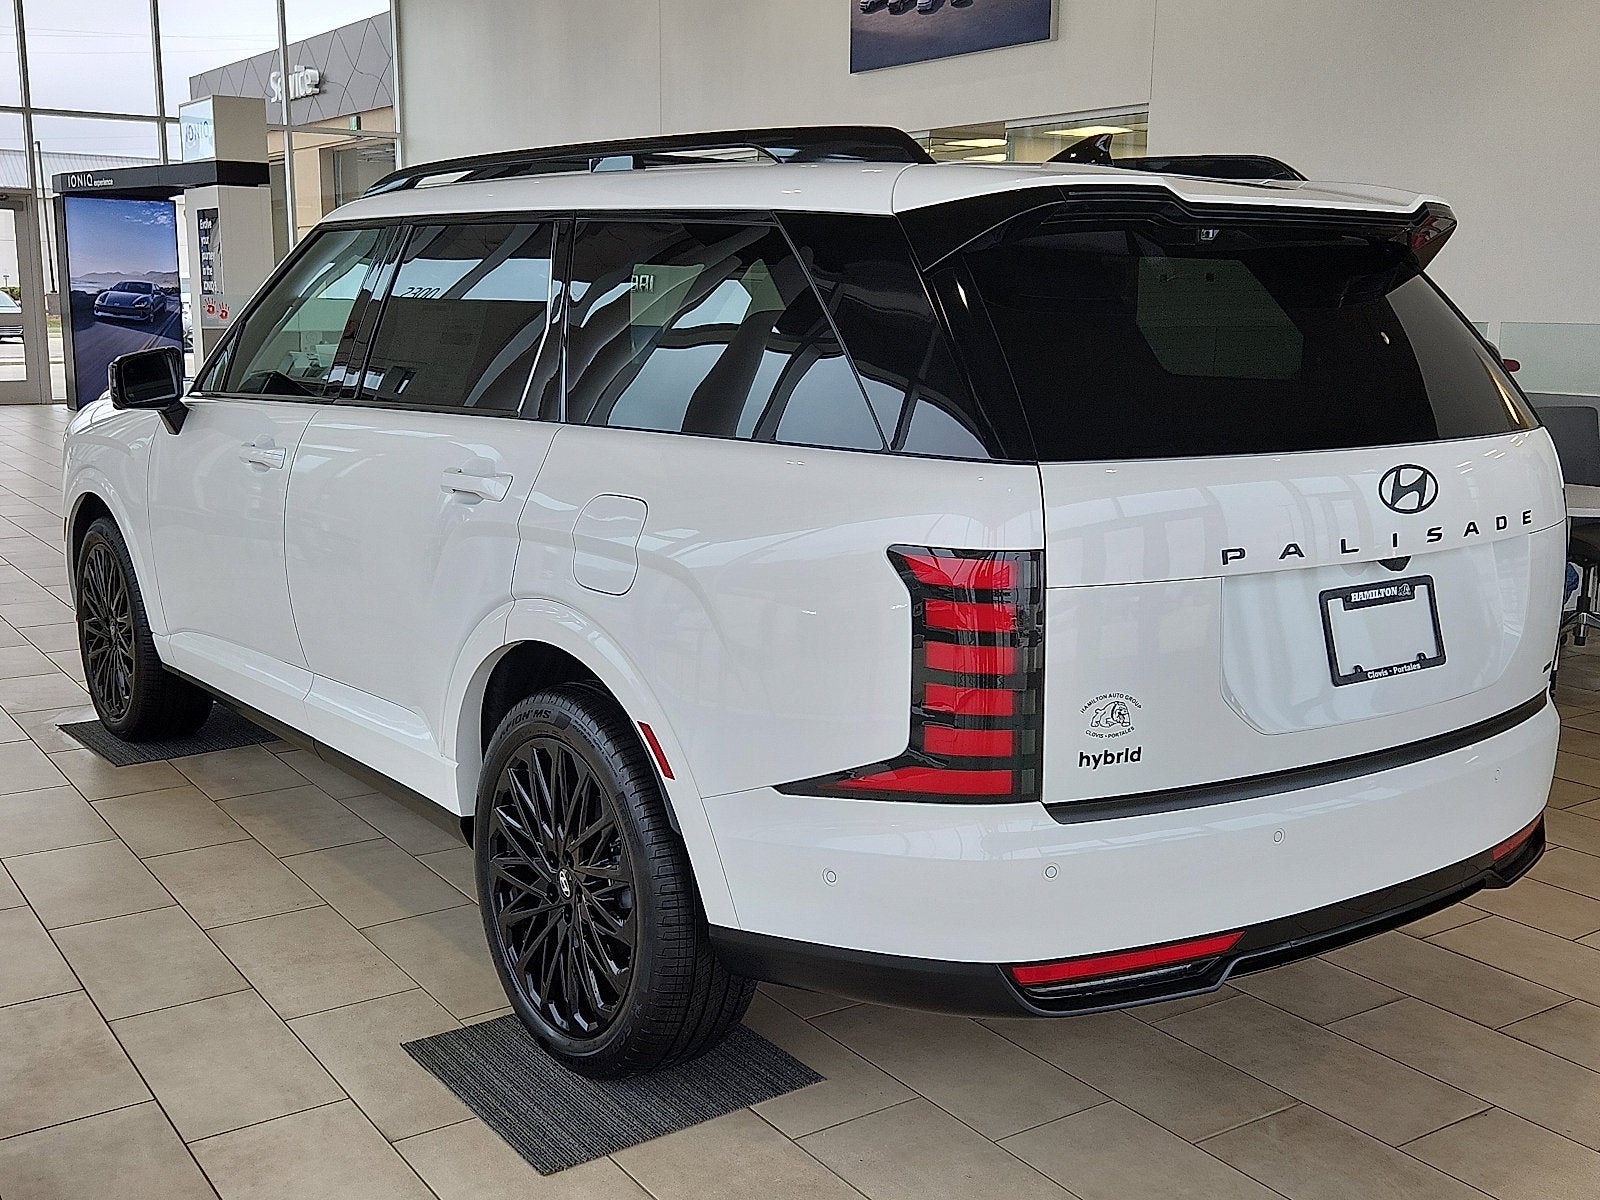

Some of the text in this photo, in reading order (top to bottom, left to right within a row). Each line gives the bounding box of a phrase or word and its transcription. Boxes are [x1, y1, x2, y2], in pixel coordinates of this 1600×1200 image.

[270, 65, 320, 102] Svice
[67, 173, 93, 188] IONIQ
[1221, 510, 1533, 565] PALISADE
[1350, 585, 1398, 602] HAMILTON
[1367, 670, 1389, 679] Clovis
[1393, 663, 1421, 675] Portales
[1080, 693, 1108, 714] HAMILTON
[1124, 694, 1142, 709] GROUP
[1085, 725, 1135, 739] CLOVIS PORTALES
[1078, 746, 1142, 770] hybrid
